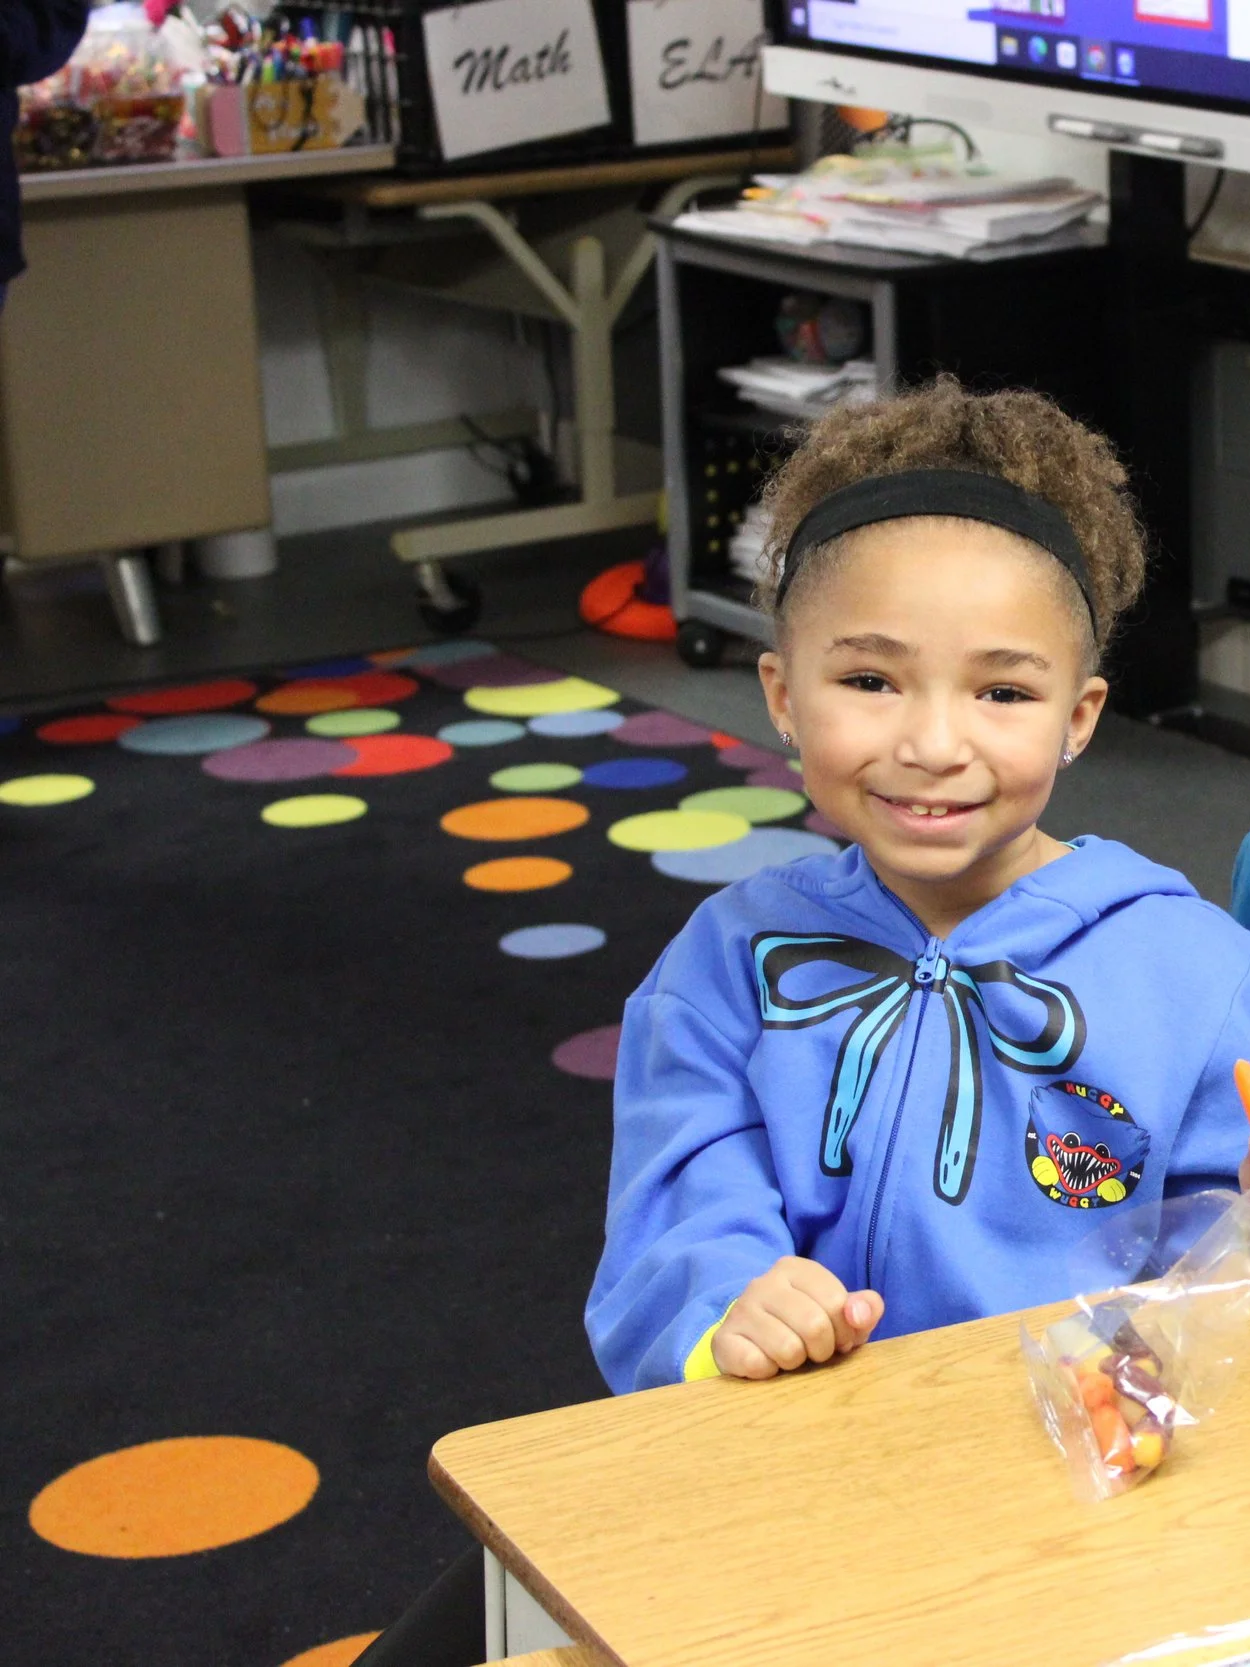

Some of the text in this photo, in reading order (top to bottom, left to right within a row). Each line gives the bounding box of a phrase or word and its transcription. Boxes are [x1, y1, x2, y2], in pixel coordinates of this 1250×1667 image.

[453, 27, 572, 95] Math
[658, 34, 766, 91] ELA
[1065, 1082, 1125, 1117] HUGGY
[1049, 1186, 1102, 1209] WUGGY
